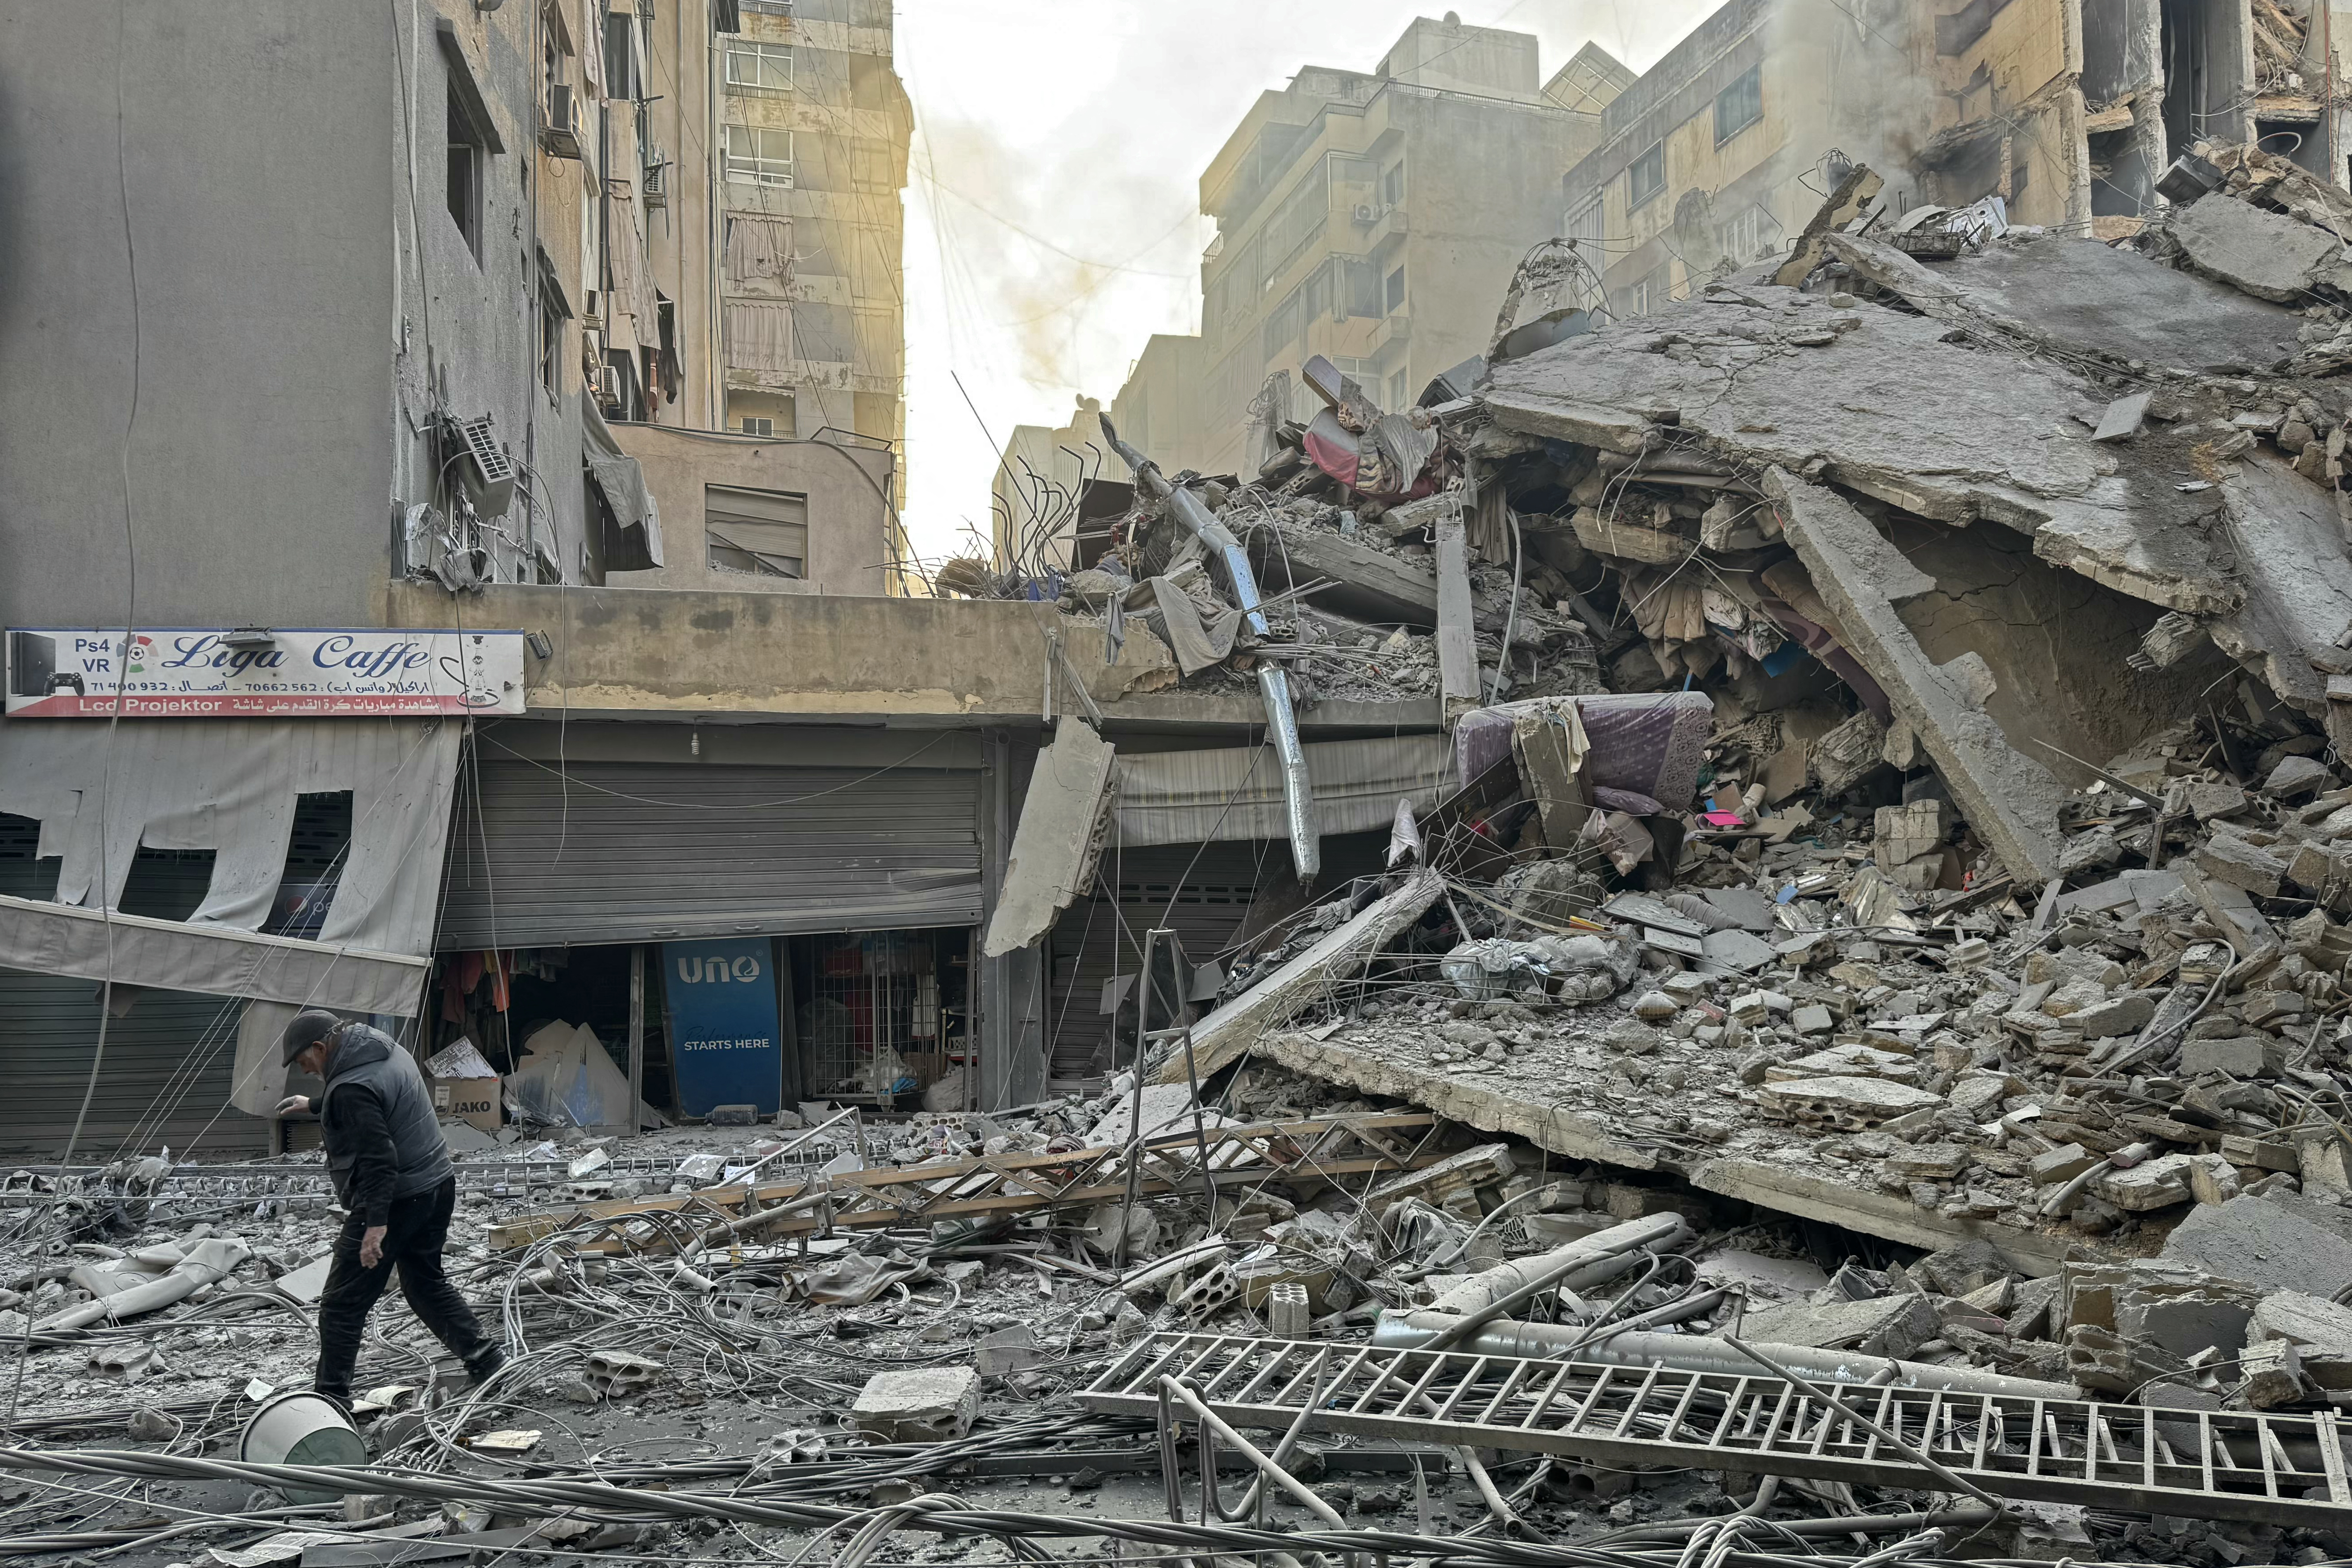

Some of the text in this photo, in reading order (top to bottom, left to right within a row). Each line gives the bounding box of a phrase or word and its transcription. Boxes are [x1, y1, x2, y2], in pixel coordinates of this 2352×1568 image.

[75, 638, 110, 652] Ps4
[161, 635, 433, 678] Liga Caffe
[82, 659, 110, 672] VR
[79, 699, 118, 711] Lcd
[125, 699, 222, 713] Projektor
[233, 698, 264, 710] شاشة
[267, 699, 289, 713] على
[292, 699, 321, 712] القدم
[324, 699, 350, 712] كرة
[353, 699, 396, 712] مباريات
[684, 1038, 770, 1051] STARTS HERE
[452, 1101, 491, 1113] JAKO
